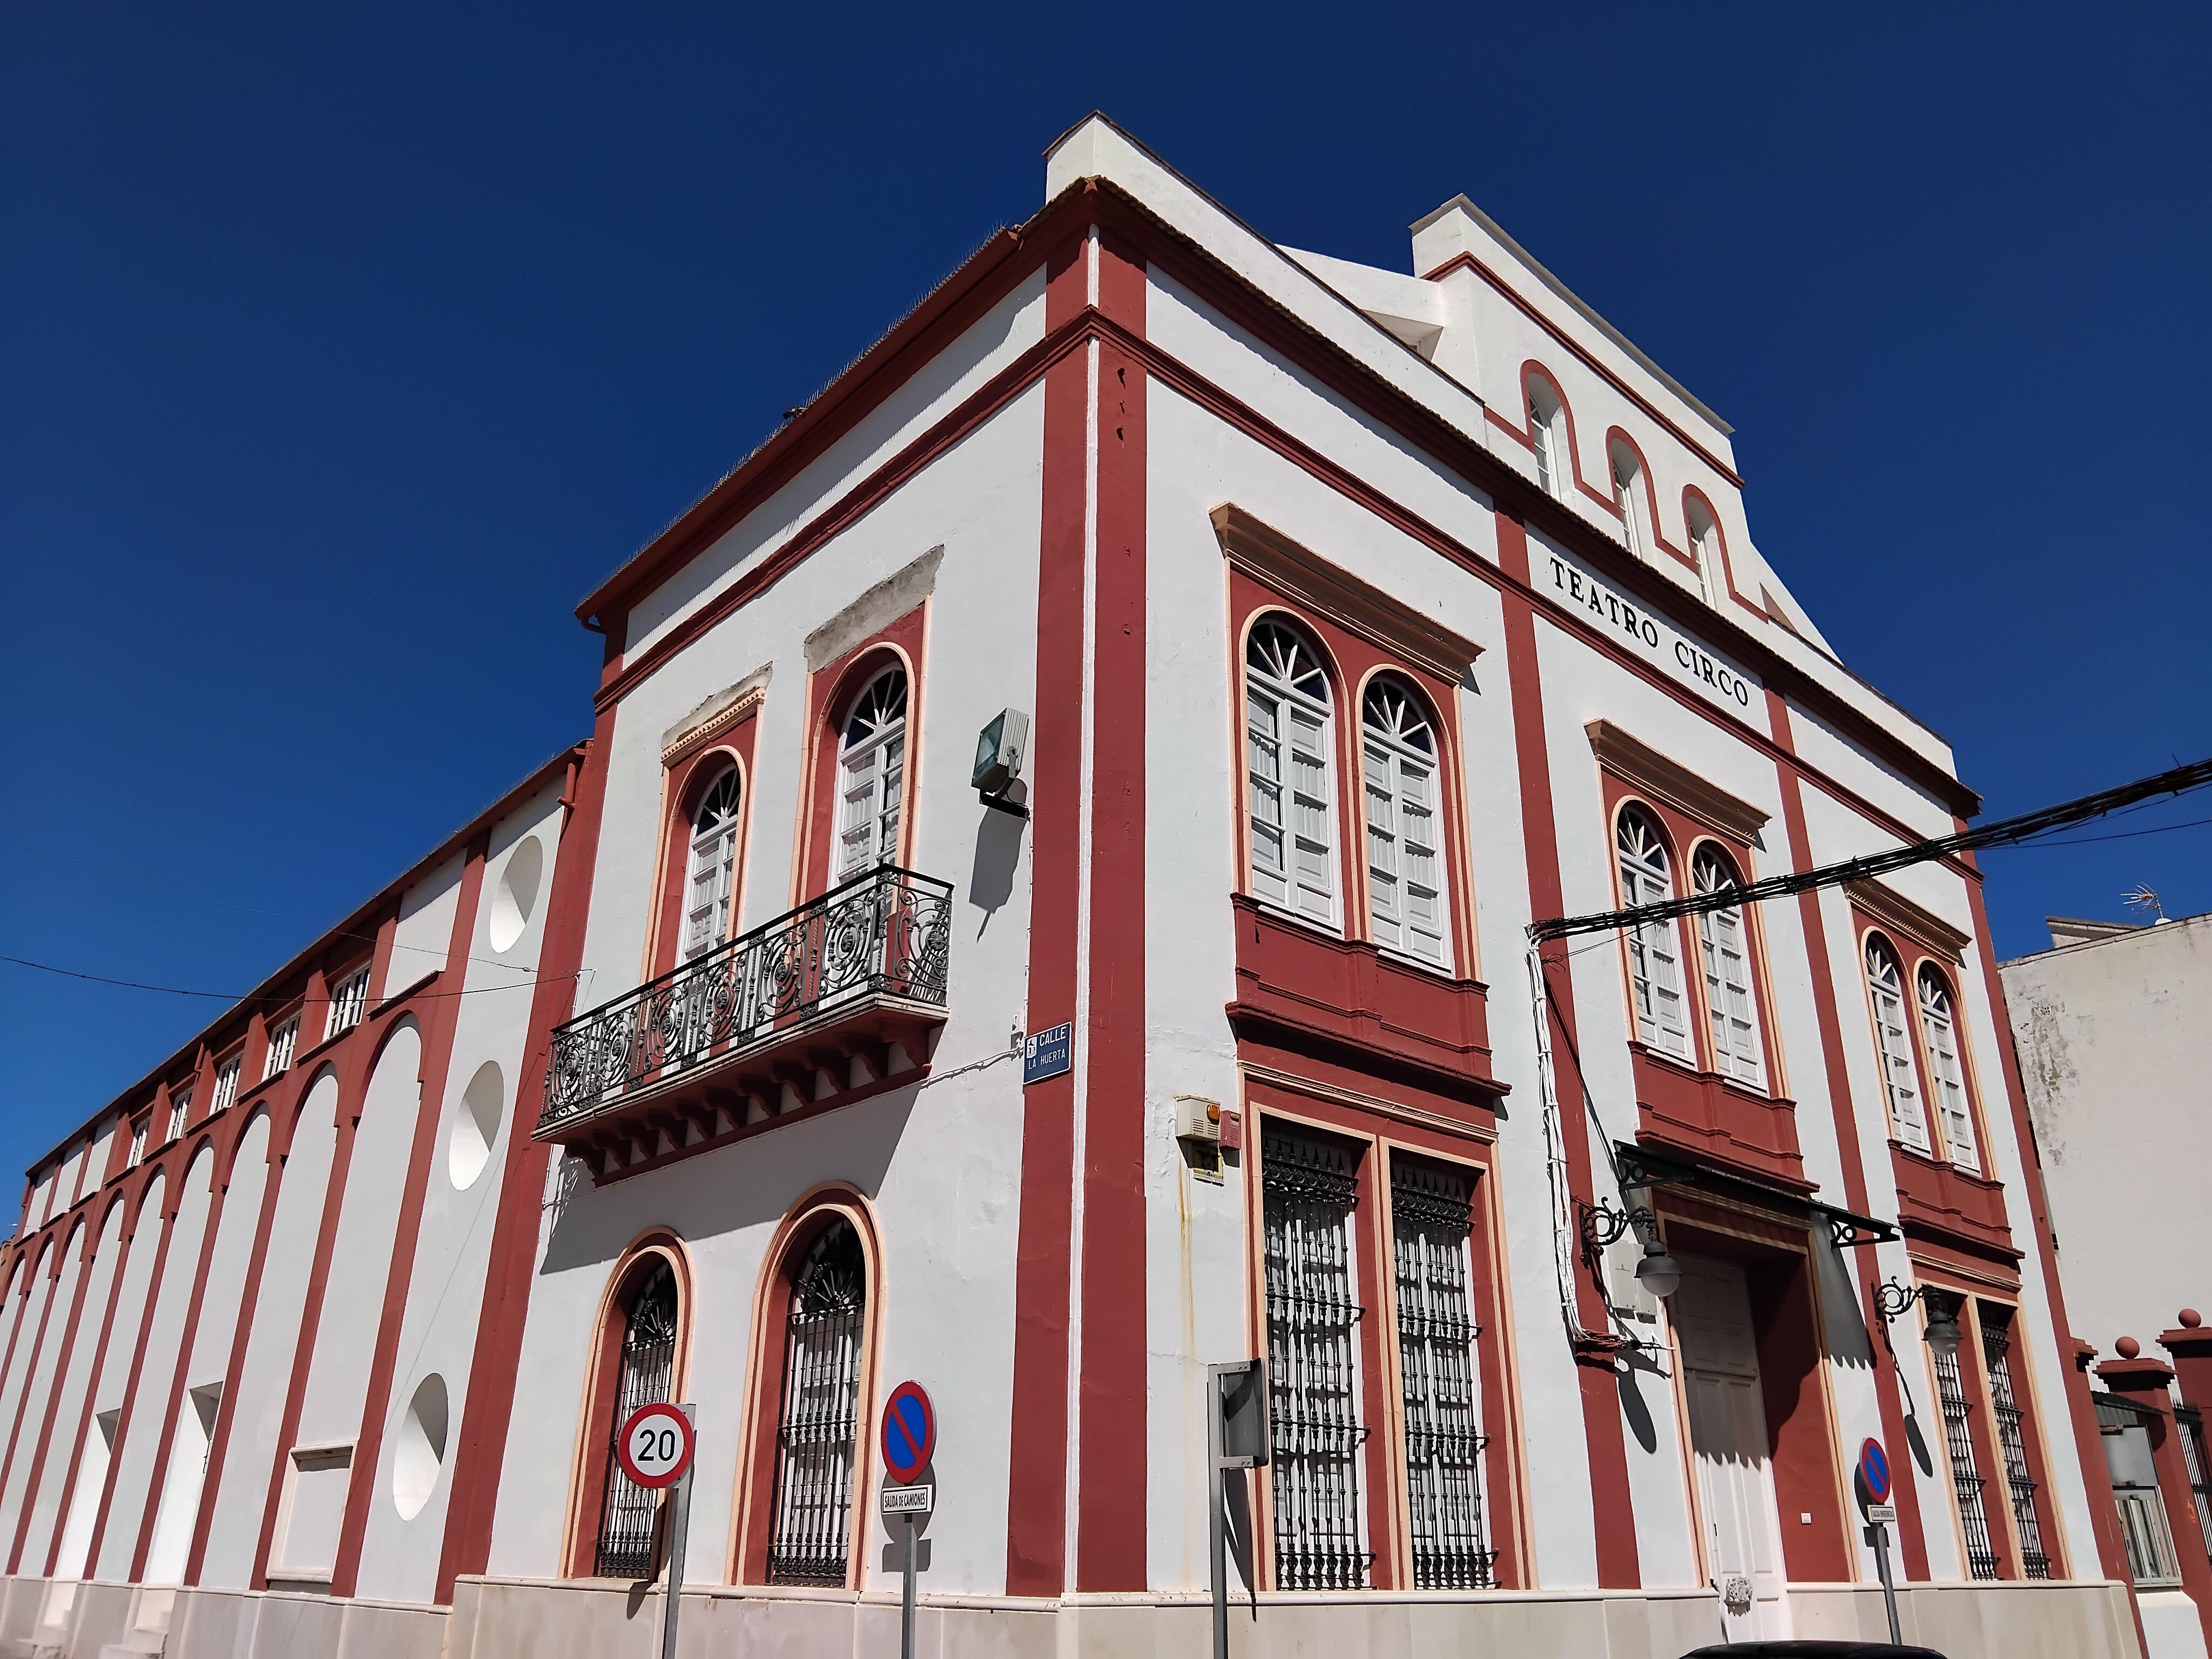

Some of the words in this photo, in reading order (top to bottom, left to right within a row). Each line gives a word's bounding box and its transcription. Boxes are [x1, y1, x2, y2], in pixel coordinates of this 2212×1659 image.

[1549, 557, 1658, 648] TEATRO
[1675, 640, 1749, 707] CIRCO
[1040, 1026, 1067, 1047] CALLE
[1028, 1058, 1036, 1070] LA
[1040, 1048, 1065, 1065] HUERTA
[637, 1429, 676, 1461] 20
[885, 1495, 898, 1508] SALIDA
[899, 1495, 903, 1507] DE
[904, 1493, 925, 1507] CAMIONES
